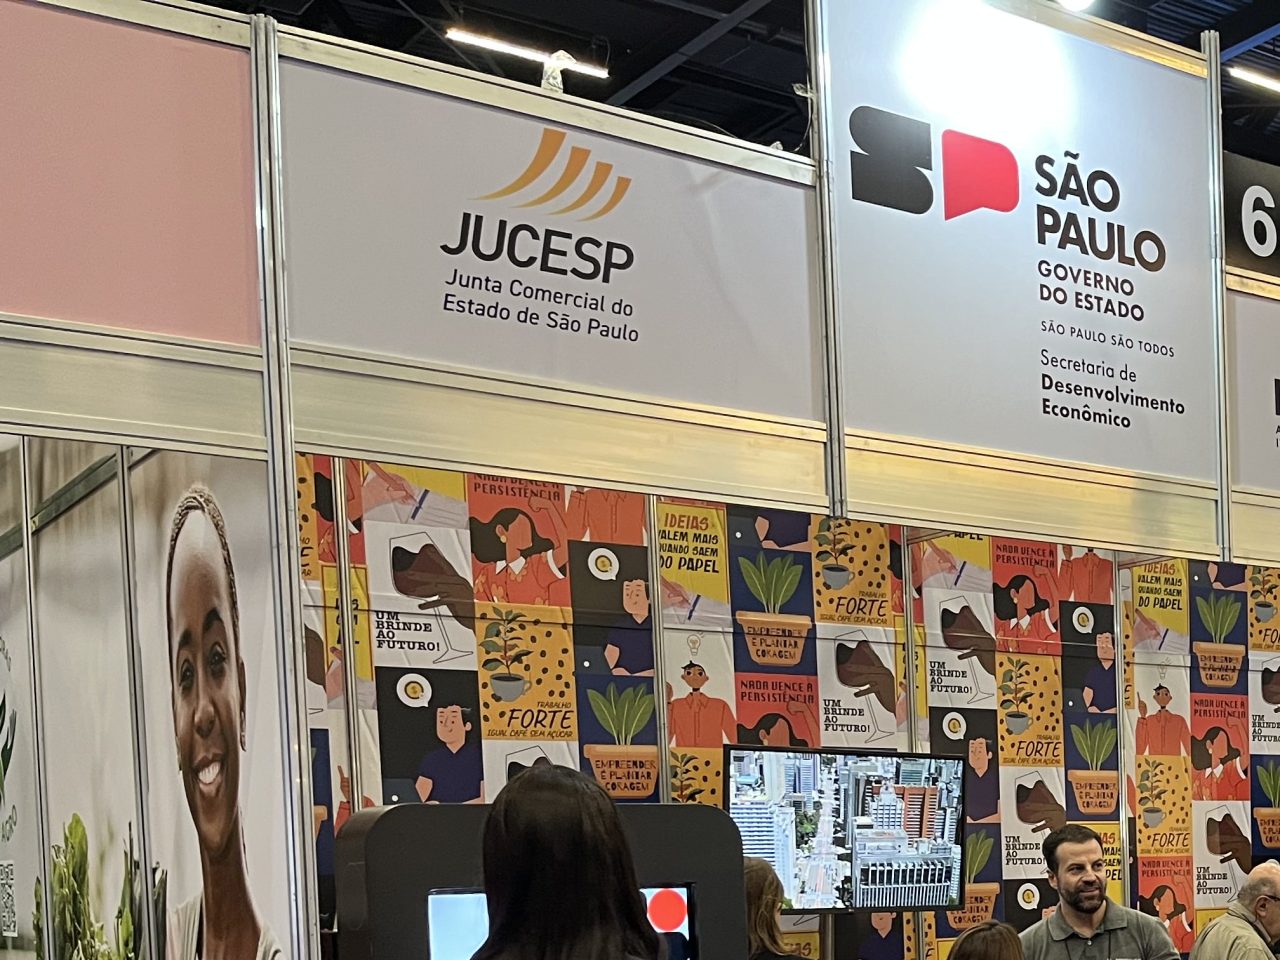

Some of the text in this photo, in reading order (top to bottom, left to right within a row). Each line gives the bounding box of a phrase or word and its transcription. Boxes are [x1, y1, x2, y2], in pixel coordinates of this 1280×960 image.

[1034, 150, 1121, 213] SÃO
[1035, 204, 1167, 273] PAULO
[440, 211, 635, 284] JUCESP
[1037, 260, 1135, 297] GOVERNO
[445, 268, 633, 317] Junta Comercial do
[1039, 284, 1145, 322] DO ESTADO
[443, 293, 639, 342] Estado de São Paulo
[1040, 320, 1175, 358] SÃO PAULO SÃO TODOS
[1040, 349, 1137, 383] Secretaria de
[1041, 373, 1186, 415] Desenvolvimento
[1042, 397, 1132, 429] Econômico
[664, 512, 709, 531] IDEIAS
[692, 533, 719, 545] MAIS
[692, 546, 719, 557] SAEM
[678, 557, 720, 574] PAPEL
[1137, 574, 1183, 587] VALEM MAIS
[1163, 587, 1183, 597] SAEM
[835, 596, 888, 617] FORTE
[1138, 596, 1183, 611] DO PAPEL
[375, 611, 400, 621] UM
[376, 620, 432, 632] BRINDE
[376, 630, 395, 639] AO
[377, 640, 440, 651] FUTURO!
[929, 661, 946, 670] UM
[929, 668, 968, 679] BRINDE
[929, 676, 943, 685] AO
[537, 701, 571, 709] TRABALHO
[823, 698, 842, 708] UM
[823, 706, 865, 717] BRINDE
[507, 708, 574, 729] FORTE
[823, 715, 838, 724] AO
[824, 723, 871, 733] FUTURO!
[1016, 740, 1062, 758] FORTE
[595, 759, 657, 770] EMPREENDER
[609, 771, 652, 780] PLANTAR
[604, 781, 649, 791] CORAGEM
[1005, 835, 1021, 844] UM
[1151, 832, 1190, 848] FORTE
[1005, 842, 1041, 851] BRINDE
[1005, 849, 1018, 858] AO
